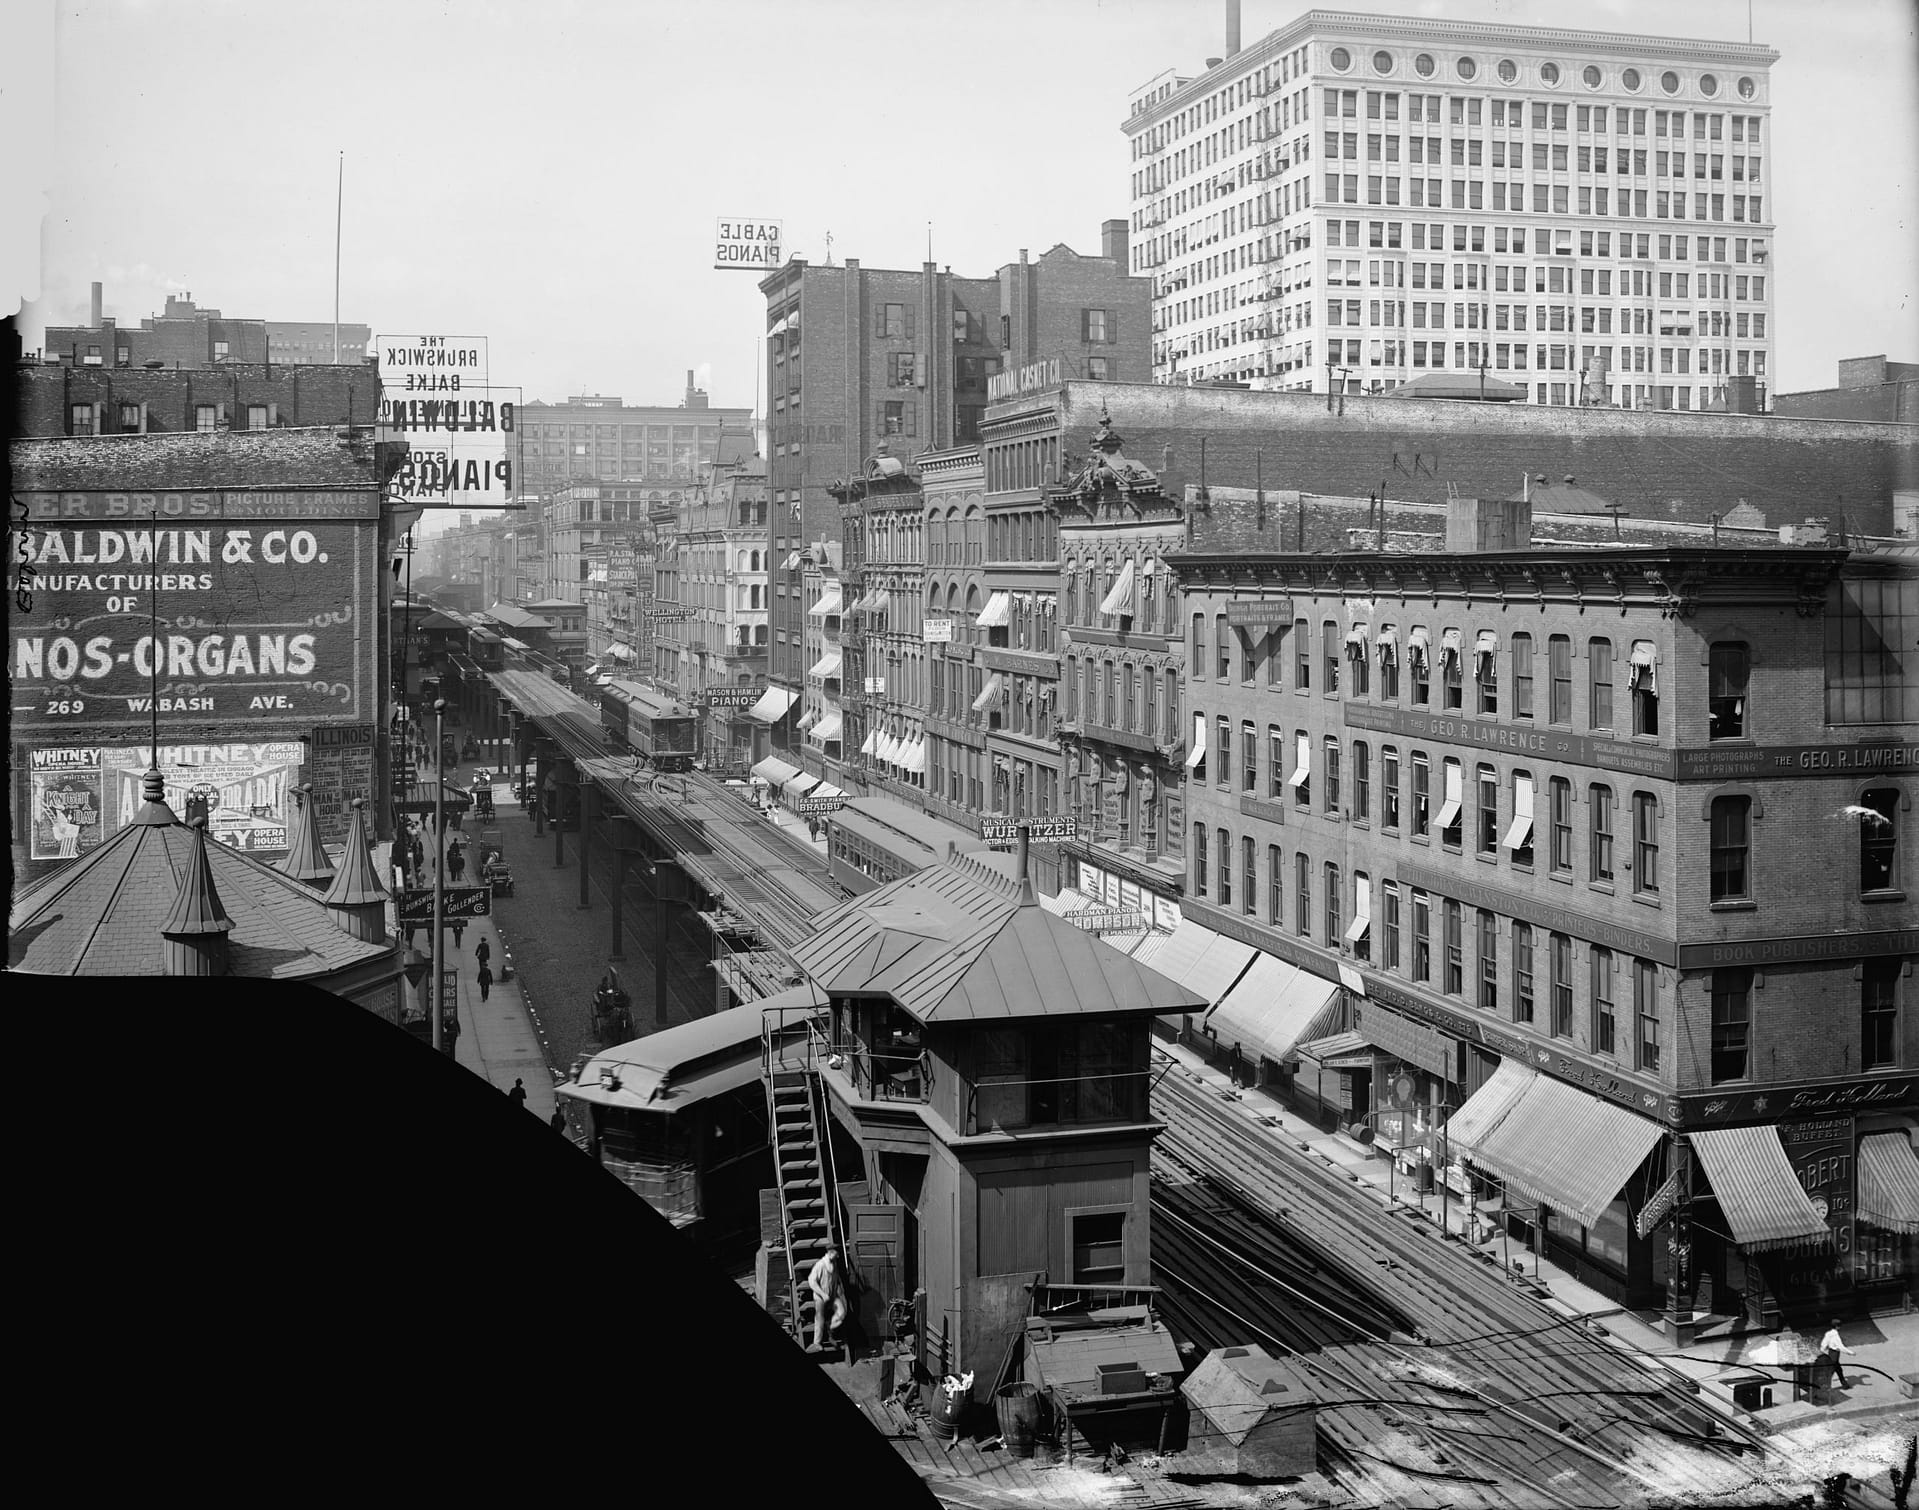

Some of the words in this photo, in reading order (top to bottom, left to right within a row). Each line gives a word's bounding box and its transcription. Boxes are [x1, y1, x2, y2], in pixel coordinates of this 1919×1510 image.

[1021, 360, 1047, 392] CASKET
[104, 492, 220, 516] BROS.
[226, 492, 295, 504] PICTURE
[304, 492, 368, 505] FRAMES
[248, 506, 368, 515] MOULDINGS
[12, 530, 211, 564] BALDWIN
[221, 530, 255, 564] &
[261, 529, 328, 564] CO.
[106, 596, 138, 613] OF
[644, 608, 696, 616] WELLINGTON
[10, 634, 317, 680] NOS-ORGANS
[707, 688, 730, 696] MASON
[738, 688, 762, 696] HAMLIN
[46, 700, 84, 715] 269
[127, 698, 214, 712] WABASH
[250, 696, 294, 709] AVE.
[711, 696, 757, 706] PIANOS
[315, 727, 371, 746] ILLINOIS
[1430, 719, 1457, 737] GEO.
[1461, 724, 1471, 739] R.
[1473, 726, 1547, 751] LAWRENCE
[269, 743, 300, 753] OPERA
[33, 749, 101, 768] WHITNEY
[136, 744, 270, 768] WHITNEY
[269, 751, 300, 761] HOUSE
[1682, 752, 1709, 763] LARGE
[1710, 750, 1765, 763] PHOTOGRAPHS
[1774, 756, 1792, 766] THE
[1800, 750, 1835, 769] GEO.
[1838, 750, 1853, 767] R.
[1621, 758, 1653, 771] ASSEMBLIES
[1692, 763, 1711, 775] ART
[193, 785, 212, 793] ONLY
[343, 789, 363, 801] MAN
[46, 790, 91, 810] KNIGHT
[313, 793, 333, 805] MAN
[319, 803, 341, 816] HOUR
[800, 802, 842, 812] BRADBU
[72, 810, 98, 825] DAY
[1028, 816, 1076, 825] STRUMENTS
[253, 829, 285, 838] OPERA
[982, 823, 1076, 838] WURITZER
[253, 836, 286, 846] HOUSE
[1066, 909, 1106, 917] HARDMAN
[1108, 907, 1137, 915] PIANOS
[1466, 888, 1518, 914] WINSTON
[1551, 912, 1596, 937] PRINTERS
[1713, 946, 1755, 961] BOOK
[1559, 1058, 1585, 1082] Fred
[1587, 1073, 1638, 1104] Holland
[1790, 1091, 1837, 1109] Fred
[1836, 1083, 1910, 1105] Holland
[1799, 1118, 1850, 1131] HOLLAND
